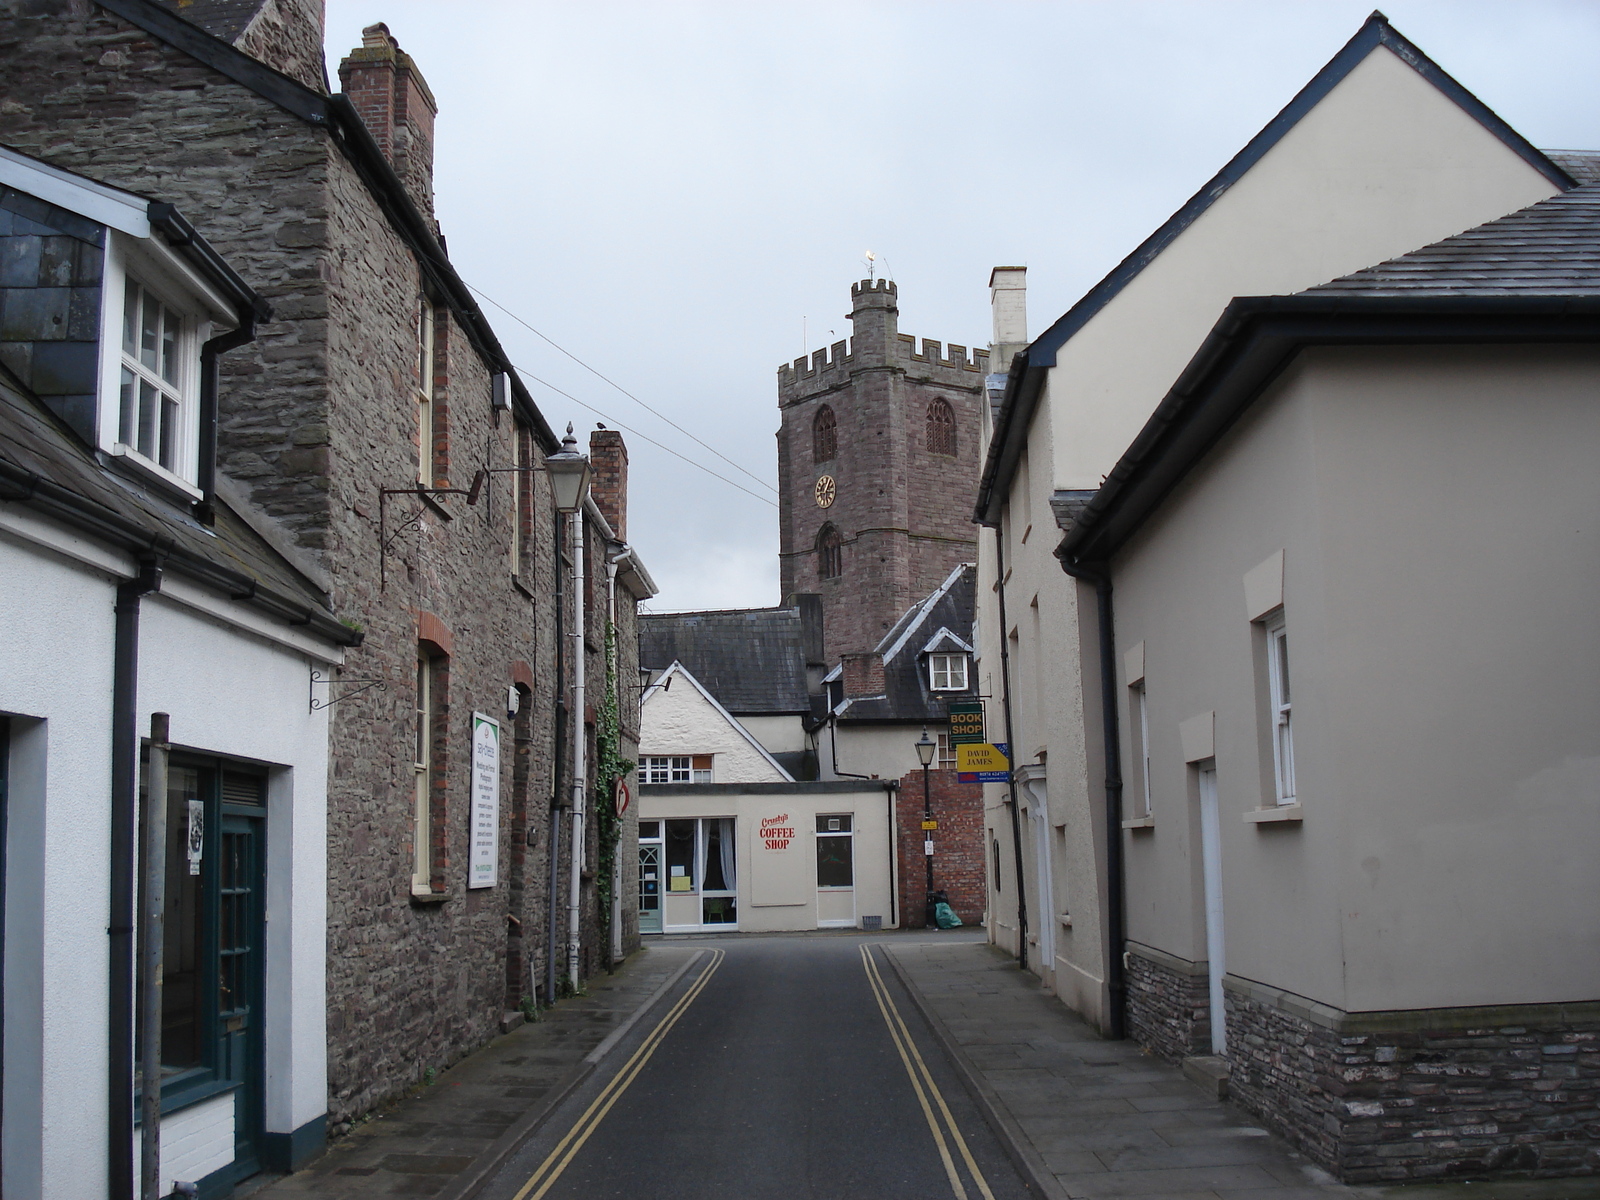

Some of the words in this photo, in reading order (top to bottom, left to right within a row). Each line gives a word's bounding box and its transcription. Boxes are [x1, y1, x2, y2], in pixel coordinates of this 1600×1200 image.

[951, 714, 982, 723] BOOK
[952, 725, 982, 734] SHOP
[966, 758, 993, 766] JAMES
[761, 813, 789, 828] Crusty's
[759, 827, 796, 838] COFFEE
[765, 839, 790, 850] SHOP
